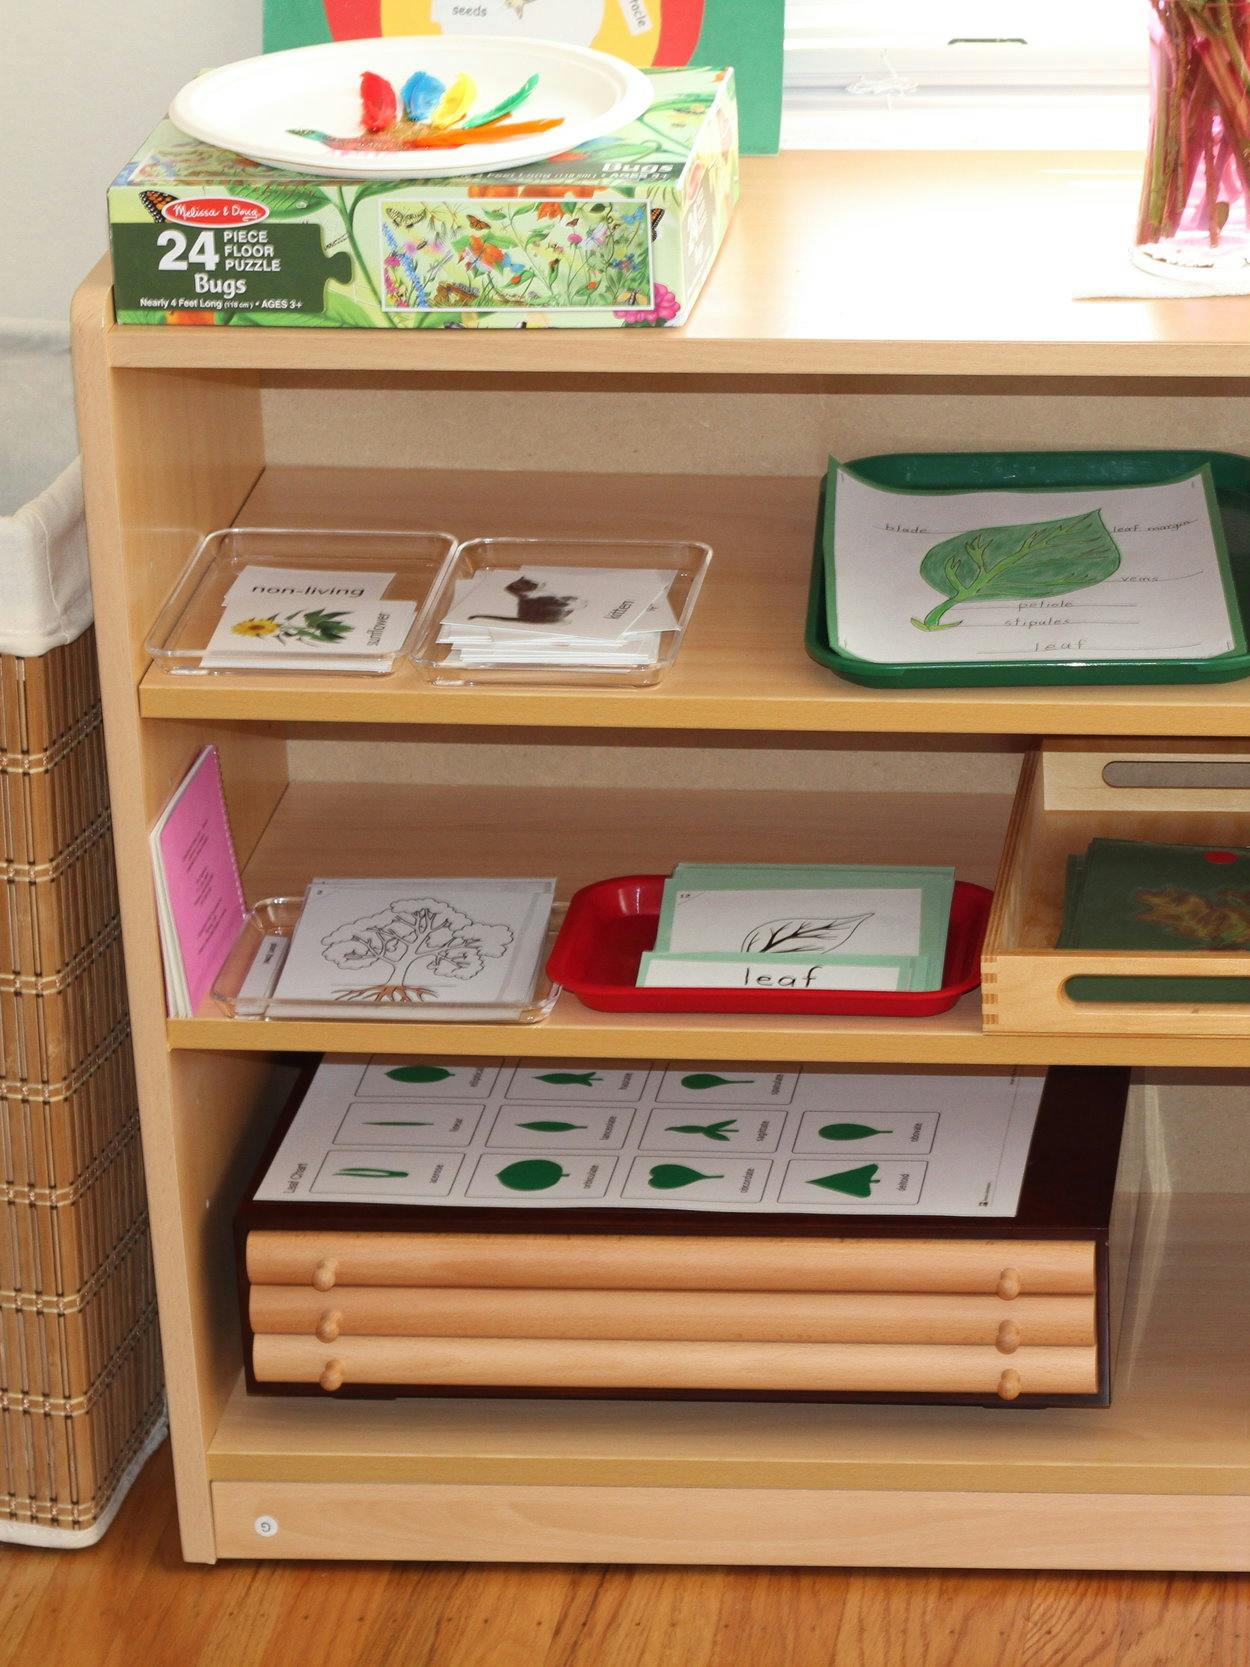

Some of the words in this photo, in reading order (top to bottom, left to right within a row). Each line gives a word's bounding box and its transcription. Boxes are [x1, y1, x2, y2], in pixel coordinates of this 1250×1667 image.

[451, 4, 487, 17] seeds
[602, 162, 674, 175] Bugs
[172, 203, 222, 219] Melissa
[231, 205, 260, 222] Doug
[223, 230, 269, 244] PIECE
[156, 228, 220, 272] 24
[224, 244, 275, 258] FLOOR
[225, 257, 282, 272] PUZZLE
[194, 272, 248, 299] Bugs
[139, 298, 169, 309] Nearly
[170, 299, 177, 308] 4
[178, 299, 199, 309] Feet
[199, 299, 222, 311] Long
[261, 299, 288, 310] AGES
[289, 299, 303, 310] 3+
[884, 522, 928, 534] blade
[1112, 524, 1141, 534] leaf
[251, 585, 366, 597] non-living
[602, 599, 635, 620] kitten
[1017, 599, 1074, 613] petiole
[366, 610, 391, 648] sunflower
[1003, 616, 1072, 630] stipules
[1033, 639, 1089, 653] leaf
[744, 964, 824, 988] leaf
[599, 1114, 618, 1142] lanceolate
[755, 1119, 771, 1143] sagittate
[909, 1121, 924, 1144] obovate
[282, 1175, 301, 1195] Leaf
[583, 1163, 601, 1191] orbiculate
[740, 1167, 757, 1195] obcordate
[896, 1172, 911, 1193] deltoid
